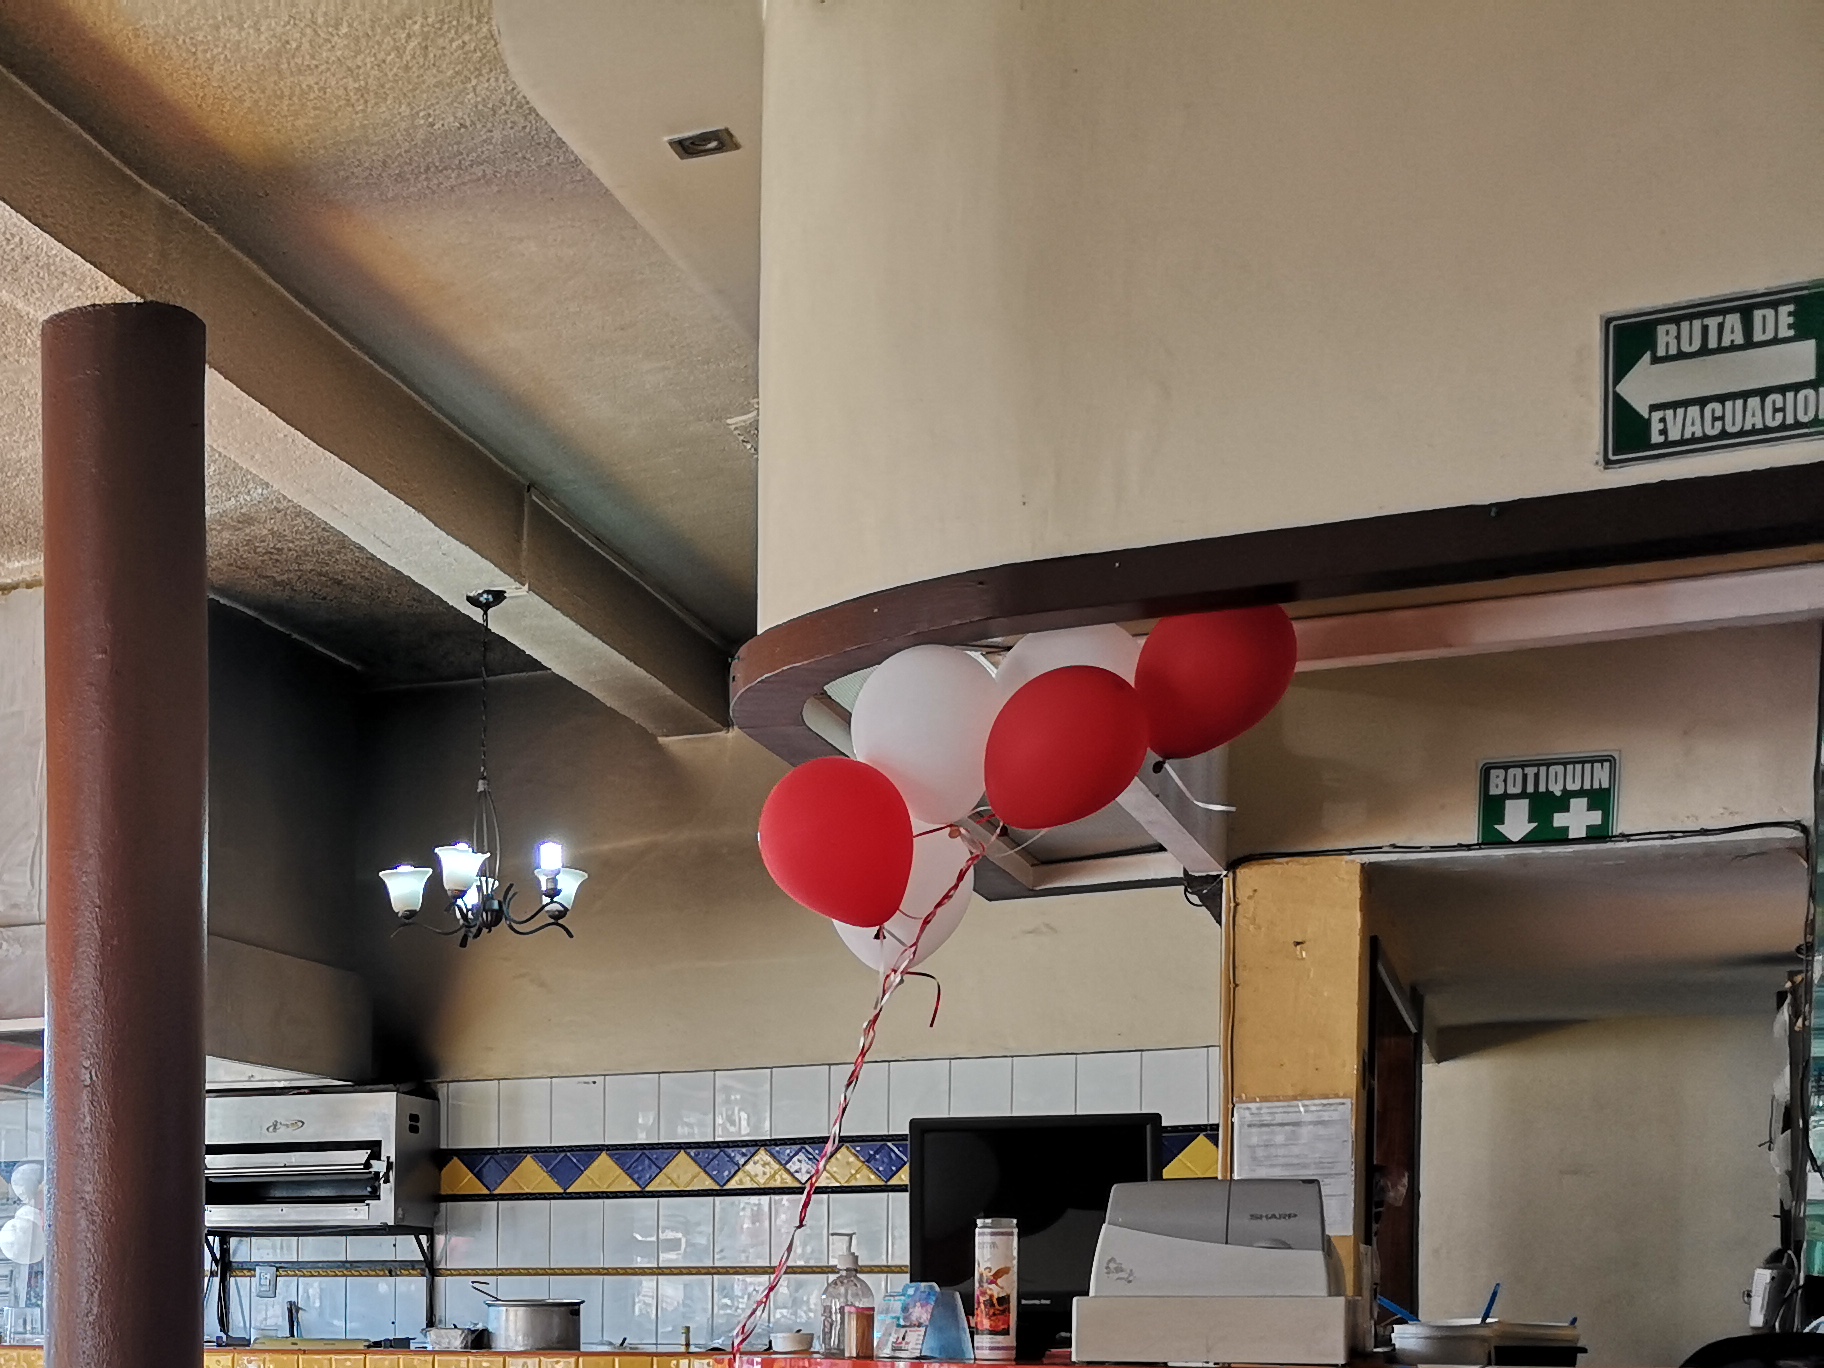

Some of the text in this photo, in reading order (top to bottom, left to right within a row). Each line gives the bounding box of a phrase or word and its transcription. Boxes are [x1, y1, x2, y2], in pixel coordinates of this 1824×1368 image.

[1656, 304, 1796, 357] RUTA DE
[1650, 387, 1824, 444] EVACUACIO
[1489, 762, 1610, 796] BOTIQUIN
[1249, 1212, 1298, 1221] SHARP
